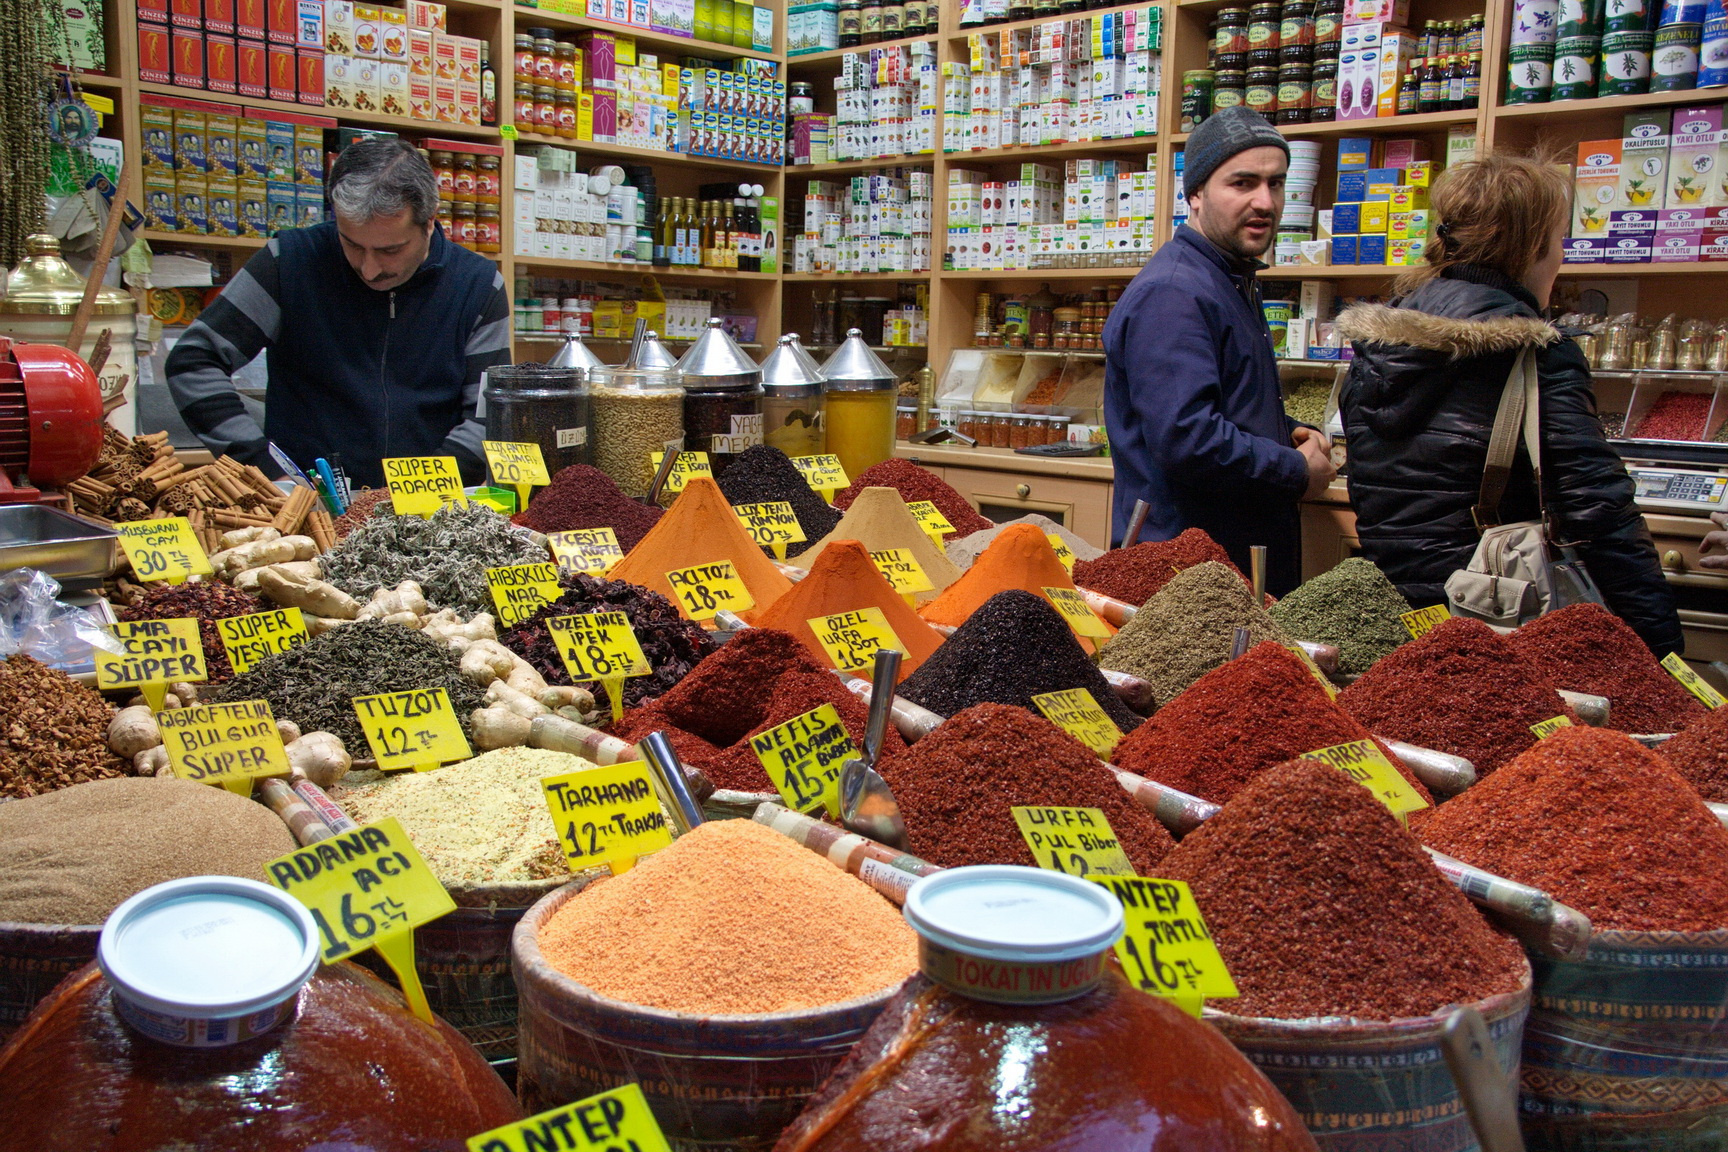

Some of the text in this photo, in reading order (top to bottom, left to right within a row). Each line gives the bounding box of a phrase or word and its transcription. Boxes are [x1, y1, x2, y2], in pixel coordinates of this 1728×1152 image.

[1624, 138, 1666, 148] OKALİPTUSLU
[1676, 135, 1694, 144] YAKI
[1695, 133, 1715, 142] OTLU
[1680, 220, 1696, 228] OTLU
[387, 458, 448, 477] SÜPER
[494, 462, 521, 482] 20
[816, 455, 841, 467] İPEK
[761, 502, 790, 516] YENİ
[120, 523, 180, 539] KUŞBURNU
[146, 535, 179, 547] ÇAYI
[134, 549, 189, 576] 30 TL
[558, 554, 589, 574] 20
[882, 563, 916, 574] TOZ
[486, 564, 558, 587] HİBİSKÜS
[505, 586, 548, 603] NAR
[684, 584, 735, 613] 18 TL
[1057, 601, 1096, 618] KEKİK
[1402, 607, 1445, 630] EXTRA
[107, 621, 171, 639] LMA
[224, 611, 293, 641] SÜPER
[550, 611, 626, 633] ÖZEL İNCE
[827, 610, 869, 633] ÖZEL
[571, 629, 613, 647] İPEK
[821, 628, 862, 646] URFA
[845, 636, 881, 652] İSOT
[103, 653, 202, 685] SÜPER
[565, 644, 612, 682] 18
[837, 649, 869, 671] 16
[355, 689, 442, 718] TUZOT
[179, 722, 273, 752] BULGUR
[377, 726, 418, 757] 12
[754, 711, 828, 754] NEFİS
[780, 723, 844, 768] ADANA
[182, 746, 271, 780] SÜPER
[547, 777, 650, 813] TARHANA
[783, 760, 825, 810] 15
[1382, 790, 1402, 799] TL
[1027, 808, 1095, 828] URFA
[565, 819, 605, 858] 12
[611, 811, 666, 839] TRAKYA
[1029, 831, 1118, 852] PUL Biber
[269, 826, 392, 891] ADANA
[1050, 849, 1090, 878] 12
[352, 851, 413, 893] ACI
[310, 892, 405, 959] 16 TL
[1143, 918, 1214, 946] TATLI
[1124, 934, 1204, 993] 16 TL
